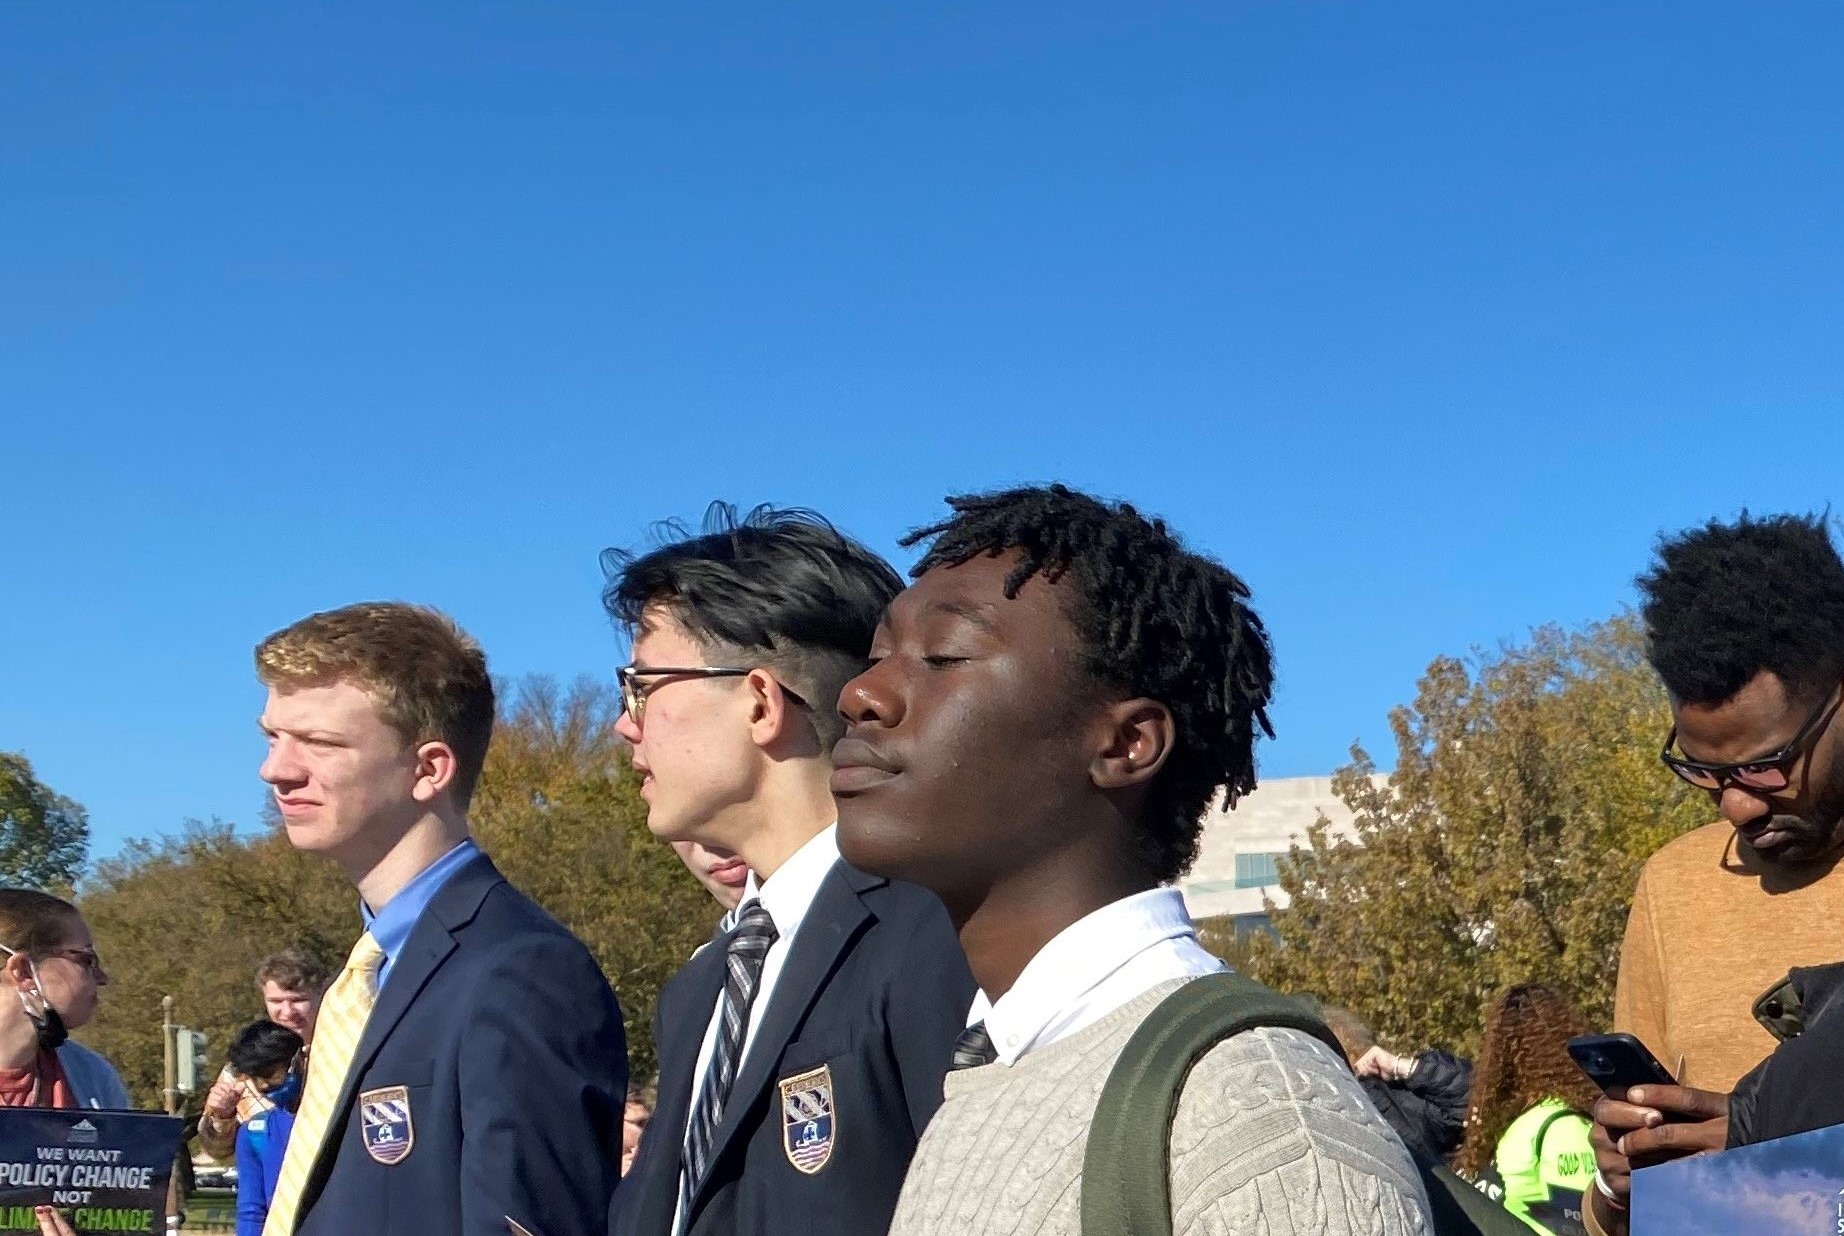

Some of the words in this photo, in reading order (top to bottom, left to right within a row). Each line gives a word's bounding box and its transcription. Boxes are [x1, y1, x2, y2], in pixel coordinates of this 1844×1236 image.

[37, 1147, 64, 1161] WE
[68, 1149, 123, 1163] WANT
[0, 1163, 71, 1187] POLICY
[71, 1167, 154, 1190] CHANGE
[53, 1190, 92, 1204] NOT
[75, 1208, 154, 1231] CHANGE
